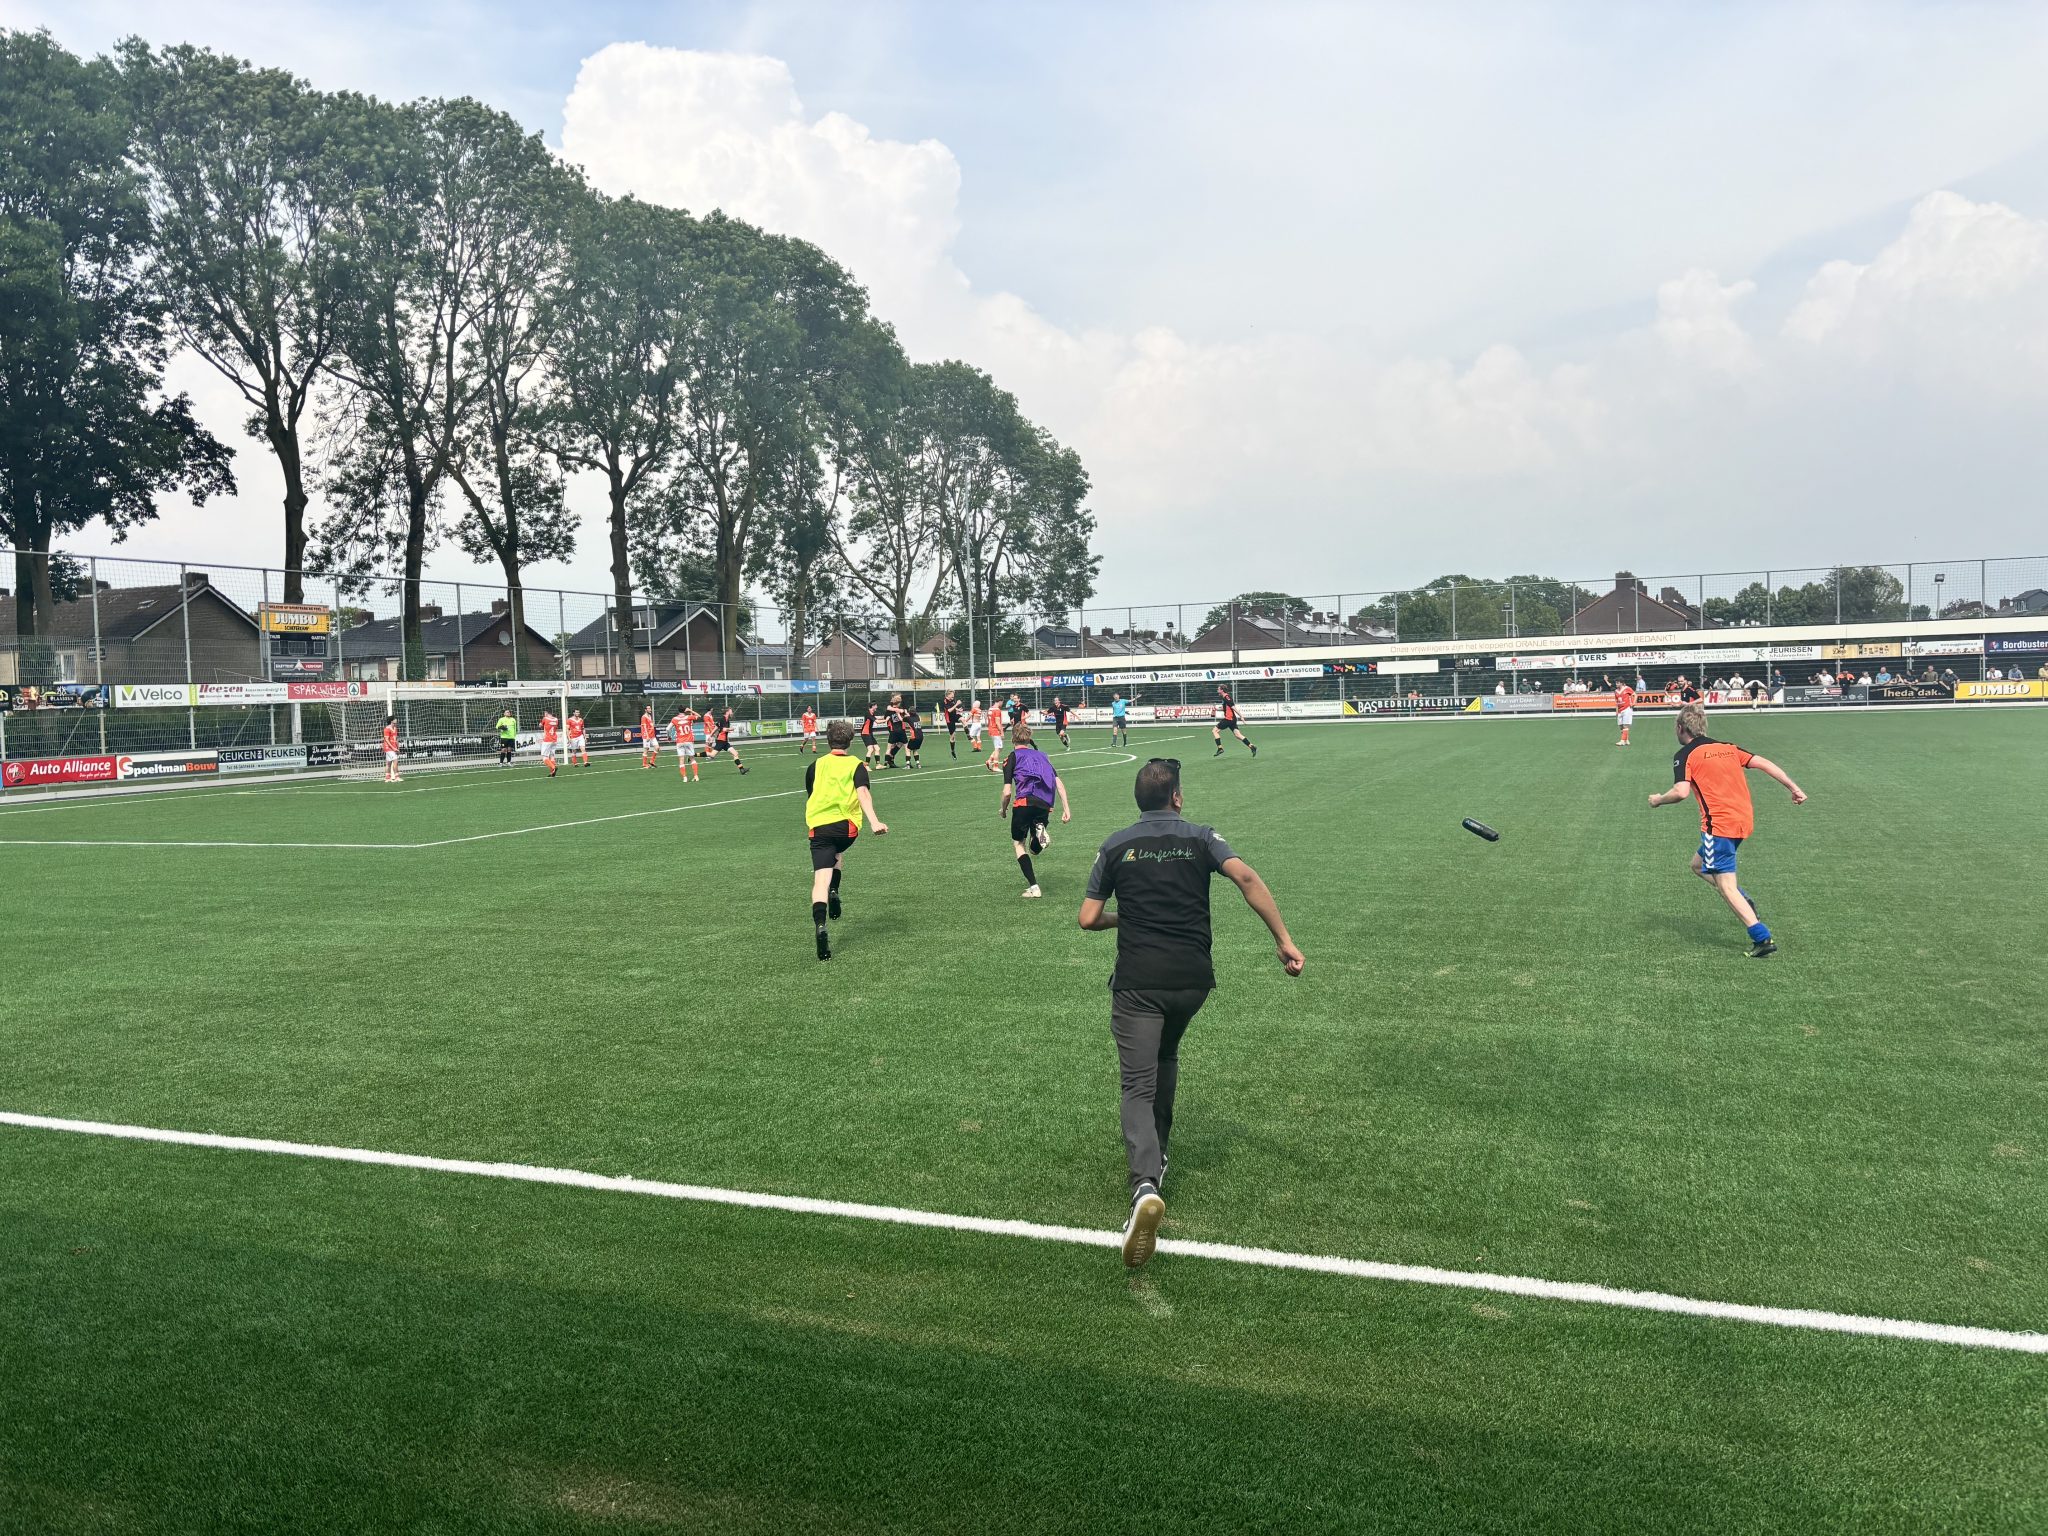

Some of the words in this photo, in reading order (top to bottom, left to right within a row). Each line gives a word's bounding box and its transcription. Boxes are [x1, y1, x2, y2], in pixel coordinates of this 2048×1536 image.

[274, 613, 318, 625] JUMBO
[1479, 642, 1513, 650] kloppend
[1634, 635, 1676, 643] BEDANKT!
[1052, 676, 1085, 684] ELTINK
[200, 684, 243, 693] Heezen
[294, 685, 318, 695] SPAR
[605, 682, 622, 693] W2D
[1883, 688, 1914, 697] Theda
[1968, 683, 2030, 696] JUMBO
[140, 688, 182, 700] Velco
[1358, 701, 1377, 713] BAS
[1378, 698, 1466, 708] BEDRIJFSKLEDING
[679, 725, 690, 736] 10
[219, 751, 256, 762] KEUKEN
[265, 748, 306, 758] KEUKENS
[30, 764, 59, 775] Auto
[63, 760, 111, 773] Alliance
